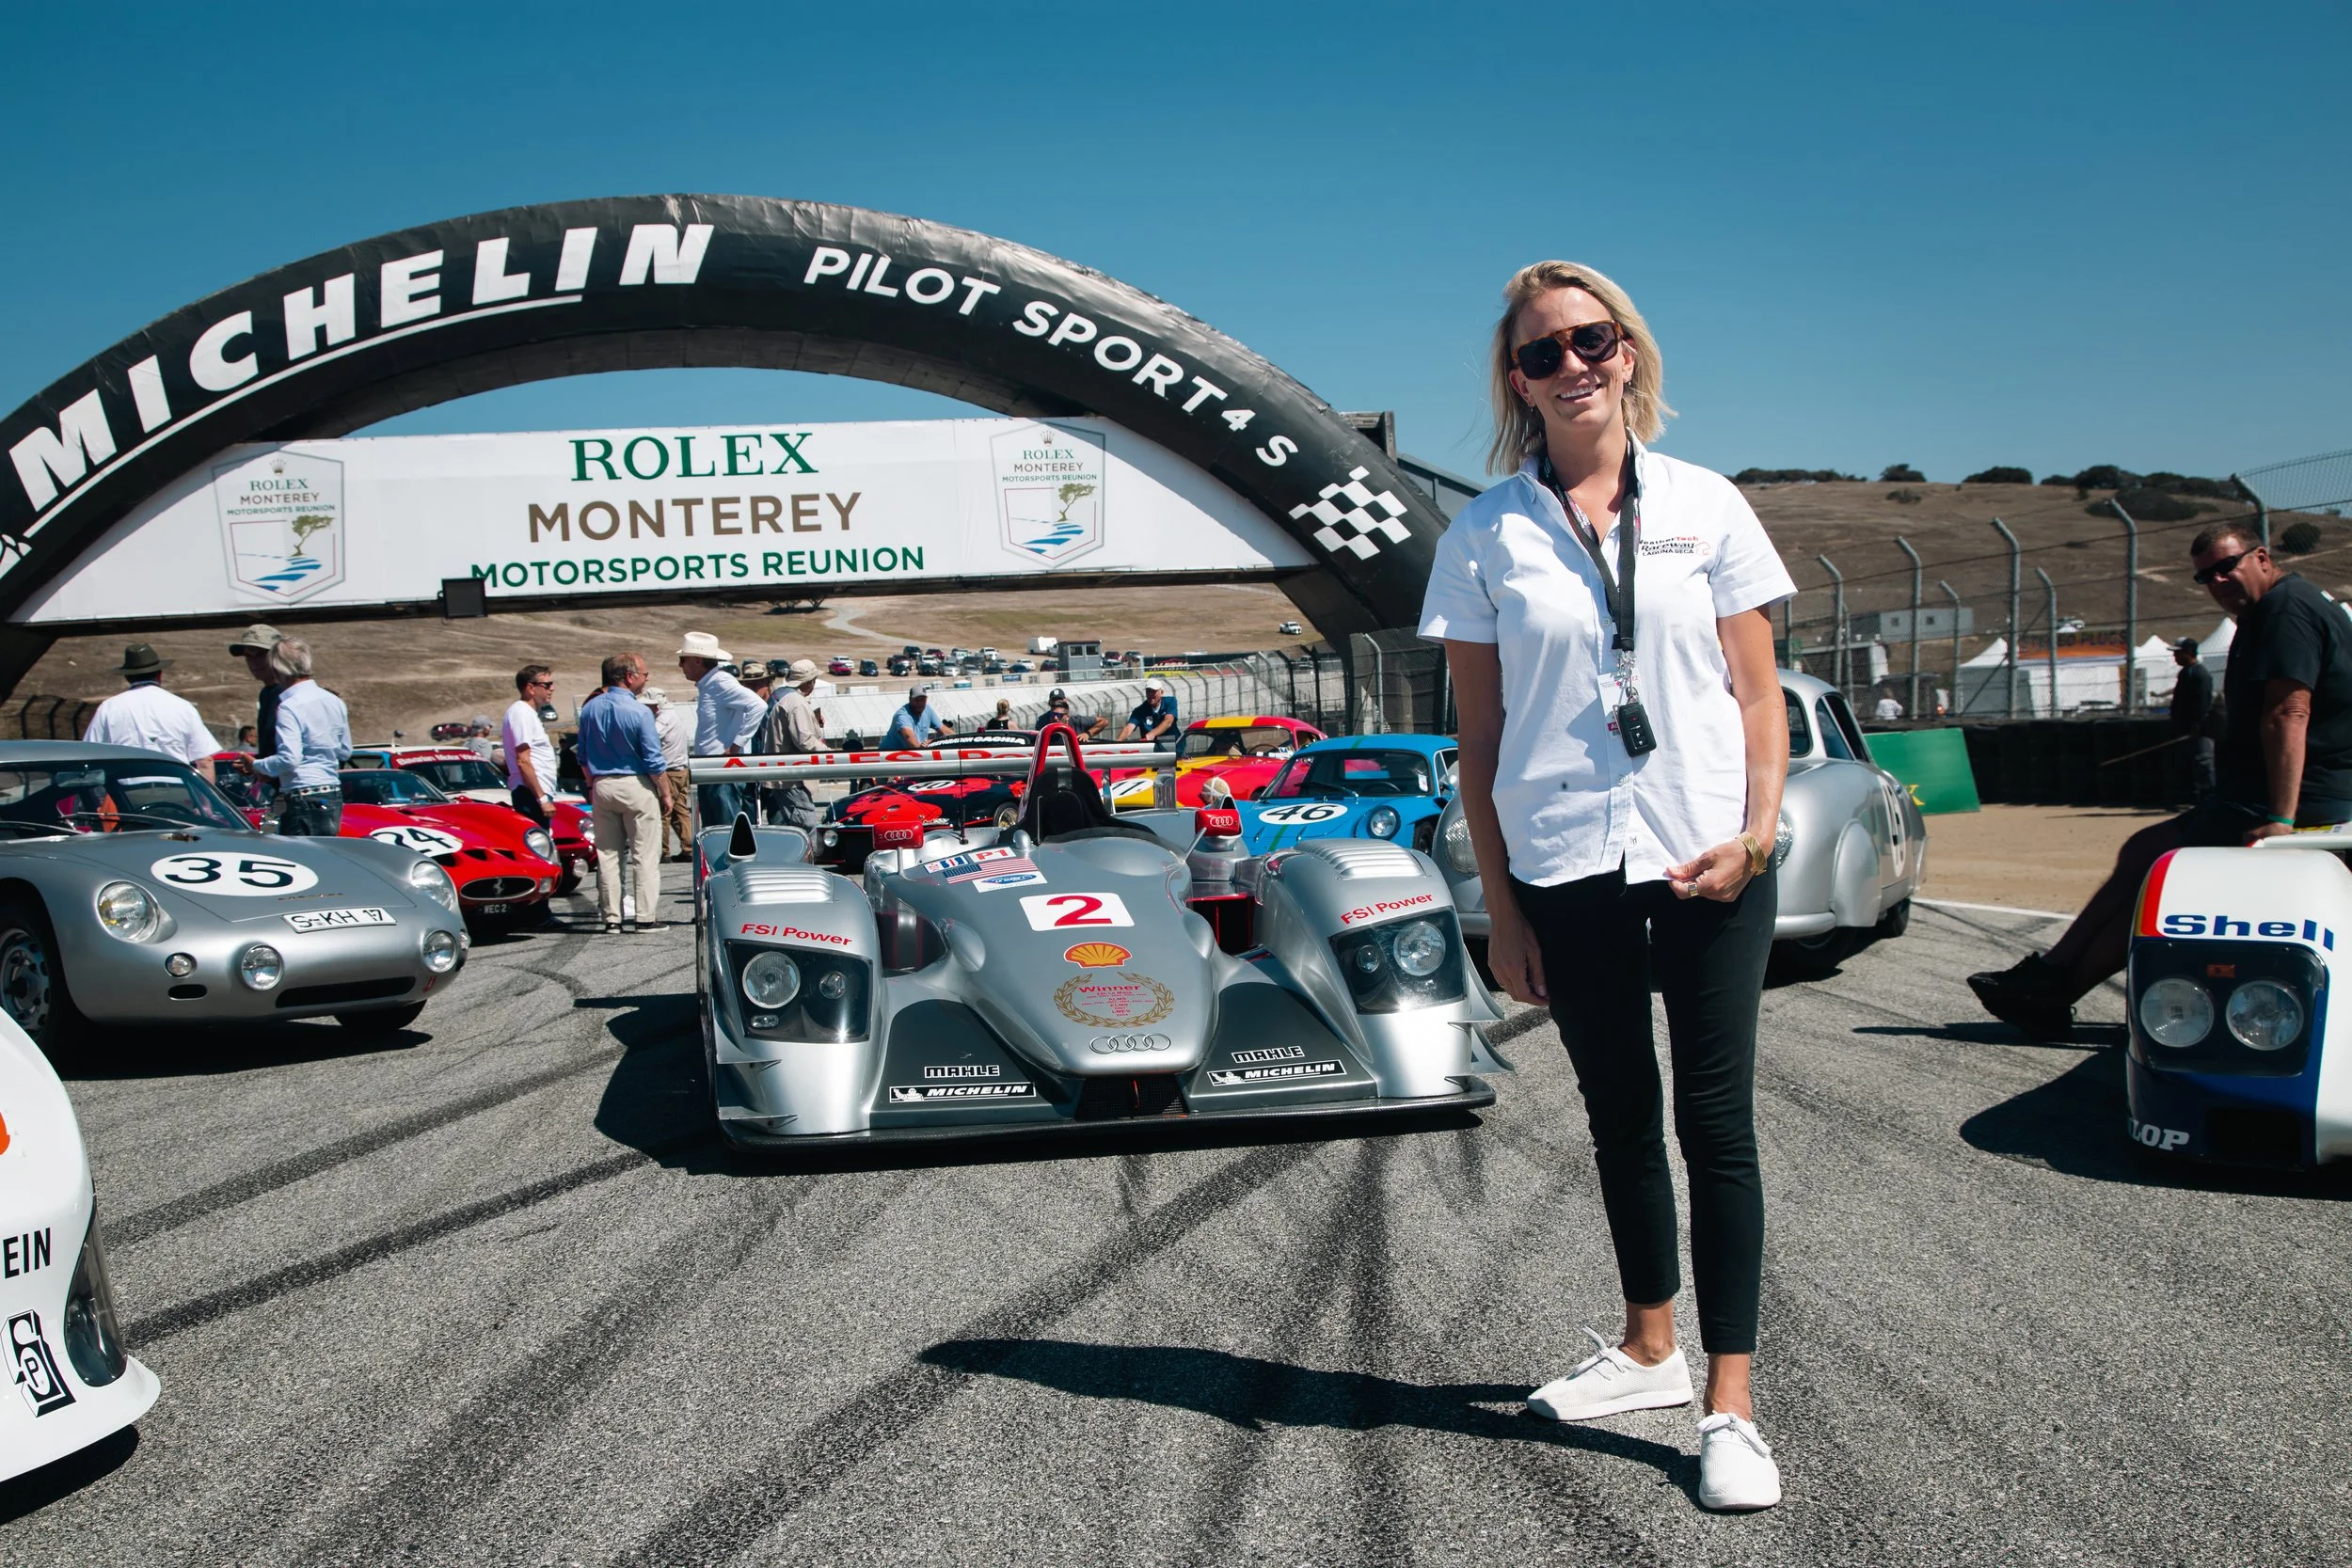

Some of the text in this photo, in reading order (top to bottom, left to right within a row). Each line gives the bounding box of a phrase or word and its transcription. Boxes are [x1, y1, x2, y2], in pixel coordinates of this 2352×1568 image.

[803, 246, 1298, 467] PILOT SPORT 4 S
[8, 224, 714, 512] MICHELIN
[570, 432, 818, 482] ROLEX
[1023, 449, 1074, 460] ROLEX
[1014, 462, 1084, 472] MONTEREY
[249, 478, 309, 491] ROLEX
[1002, 474, 1060, 483] MOTORSPORTS
[240, 493, 320, 505] MONTEREY
[227, 504, 336, 515] MOTORSPORTS REUNION
[529, 491, 862, 543] MONTEREY
[471, 546, 924, 588] MOTORSPORTS REUNION
[917, 780, 949, 789] 40
[1266, 805, 1336, 821] 46
[371, 828, 453, 852] 24
[976, 849, 1009, 861] P1
[167, 855, 297, 888] 35
[1046, 895, 1113, 927] 2
[1340, 893, 1434, 927] FSI Power
[740, 923, 853, 946] FSI Power
[2164, 914, 2334, 952] Shell
[1078, 985, 1140, 993] Winner
[1232, 1045, 1306, 1064] MAHLE
[924, 1064, 1000, 1078] MAHLE
[1244, 1063, 1337, 1079] MICHELIN
[926, 1083, 1029, 1098] MICHELIN
[2129, 1117, 2190, 1151] LOP
